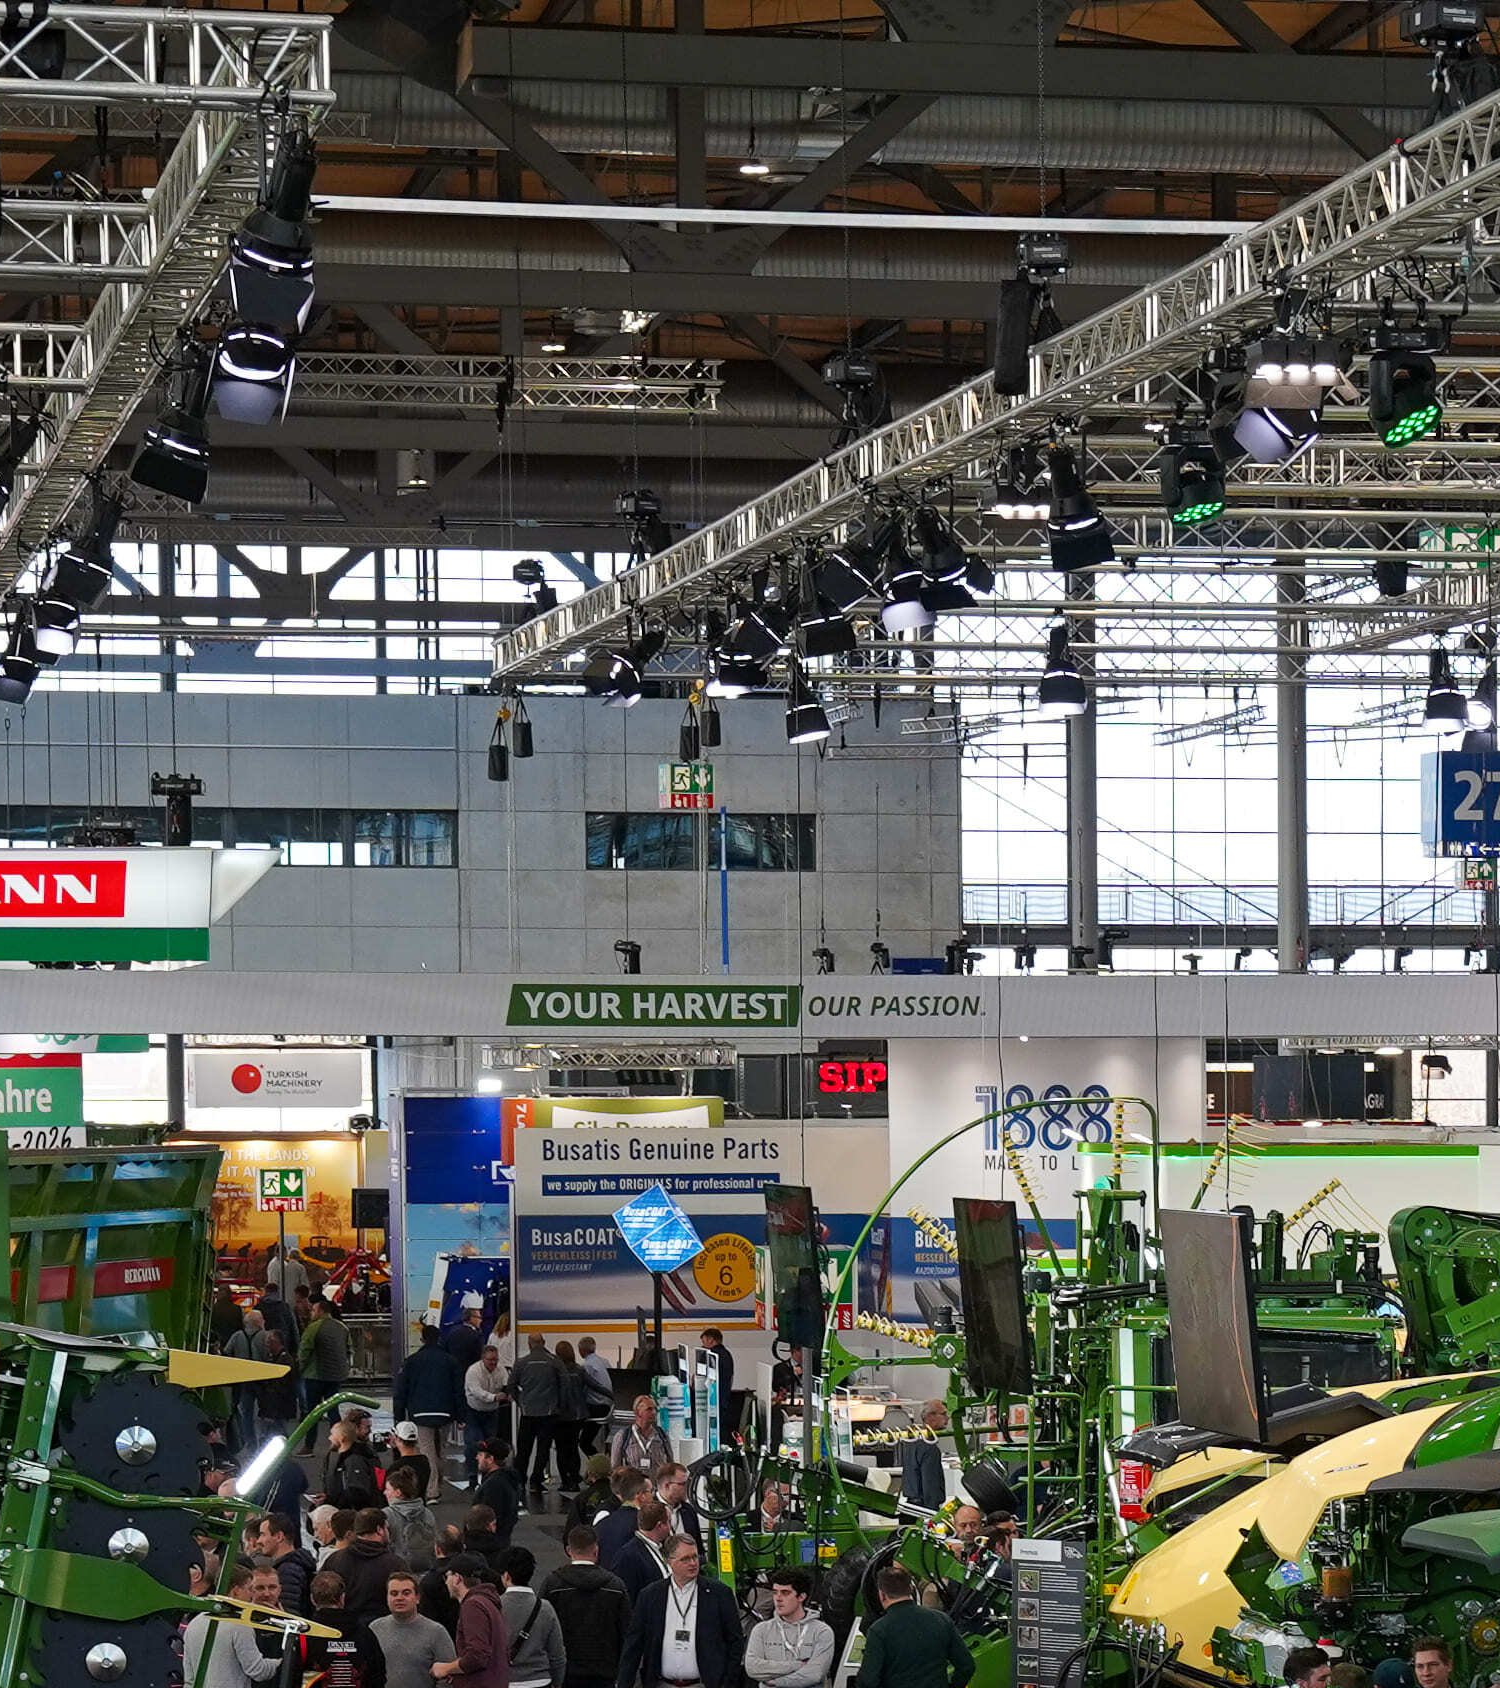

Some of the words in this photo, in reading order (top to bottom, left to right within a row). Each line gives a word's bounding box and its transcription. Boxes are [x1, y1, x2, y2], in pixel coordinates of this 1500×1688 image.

[522, 991, 622, 1021] YOUR
[632, 990, 787, 1021] HARVEST
[808, 995, 864, 1017] OUR
[867, 994, 987, 1018] PASSION.
[266, 1080, 323, 1088] MACHINERY
[819, 1062, 887, 1093] SIP
[975, 1084, 1113, 1151] 1888
[267, 1149, 309, 1161] LANDS
[543, 1138, 620, 1161] Busatis
[629, 1138, 714, 1161] Genuine
[723, 1138, 780, 1161] Parts
[1040, 1155, 1058, 1171] TO
[547, 1181, 561, 1191] we
[564, 1180, 597, 1193] supply
[600, 1179, 616, 1190] the
[674, 1178, 690, 1190] for
[692, 1178, 754, 1192] professional
[715, 1253, 726, 1264] up
[728, 1251, 738, 1262] to
[124, 1266, 161, 1284] BERGMANN
[719, 1265, 733, 1286] 6
